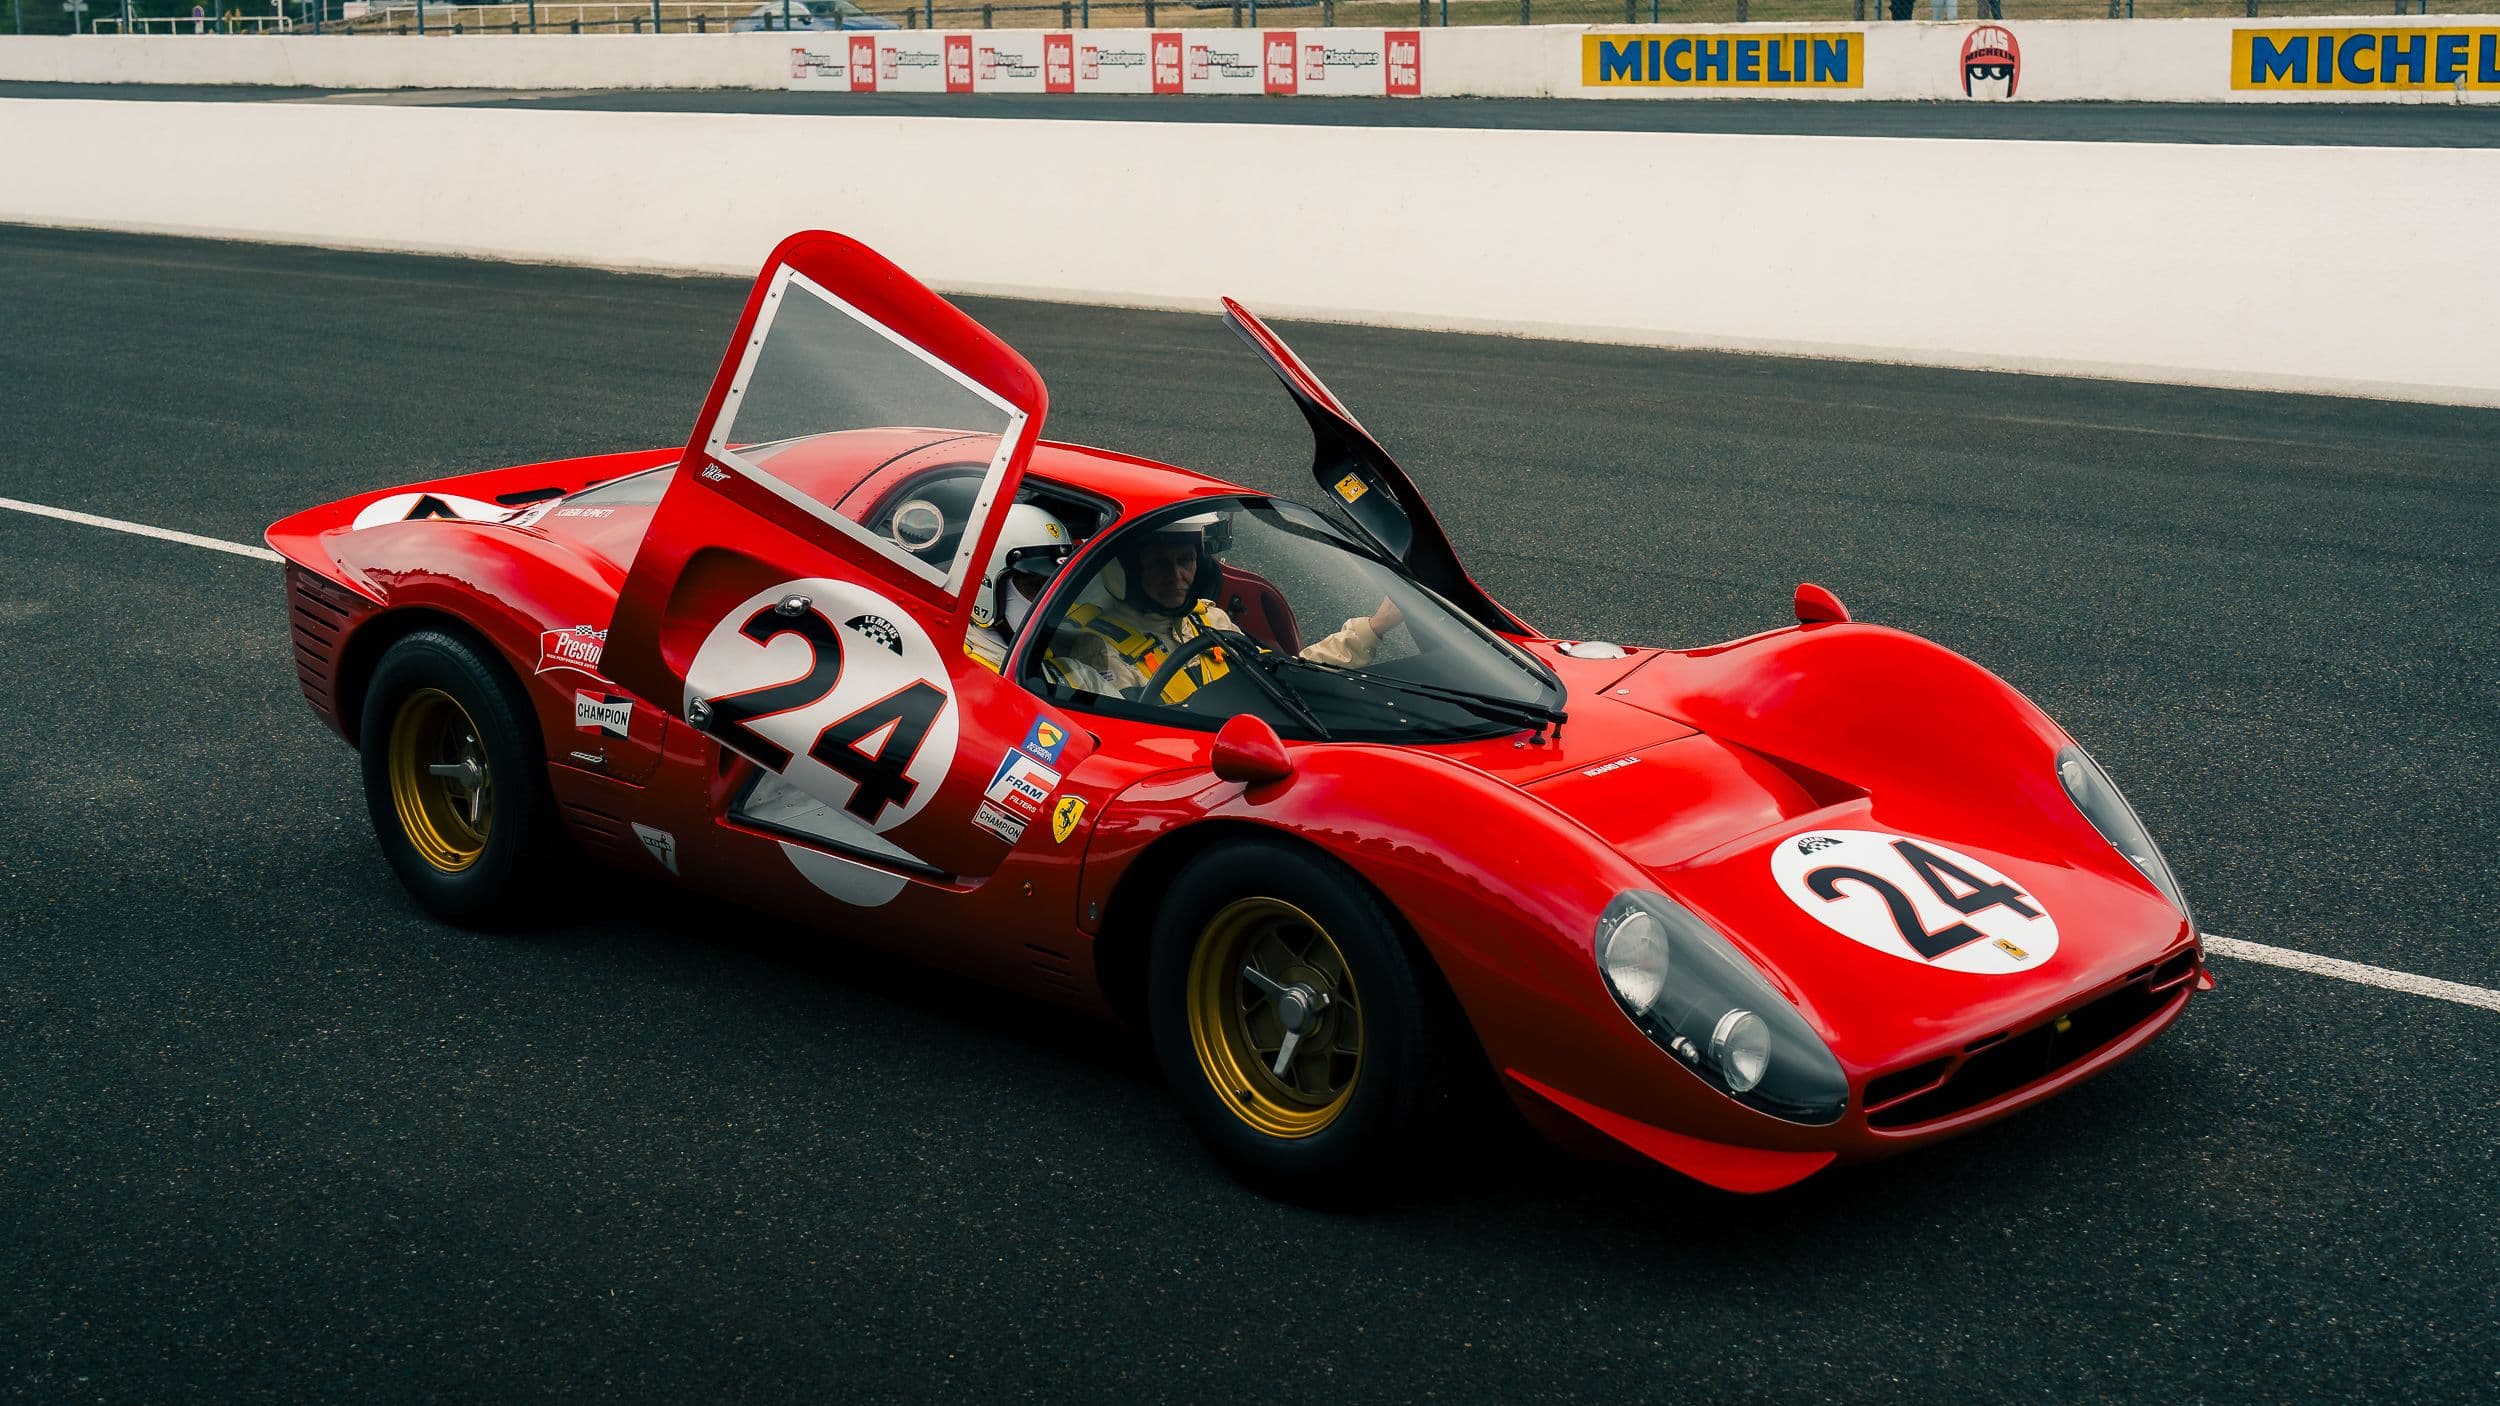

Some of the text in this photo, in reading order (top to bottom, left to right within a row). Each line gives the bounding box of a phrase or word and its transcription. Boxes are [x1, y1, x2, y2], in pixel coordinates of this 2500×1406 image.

[1207, 51, 1239, 66] Young
[1267, 42, 1292, 64] Auto
[1323, 49, 1379, 68] Classiques
[1389, 40, 1416, 64] Auto
[1600, 39, 1849, 83] MICHELIN
[1965, 47, 2015, 63] MICHELIN
[2251, 33, 2500, 84] MICHEL
[1267, 64, 1293, 84] Plus
[1390, 65, 1416, 86] Plus
[577, 703, 629, 726] CHAMPION
[703, 603, 949, 826] 24
[1005, 775, 1044, 800] FRAM
[1009, 794, 1038, 814] FILTERS
[979, 810, 1020, 839] CHAMPION
[1803, 839, 2046, 962] 24
